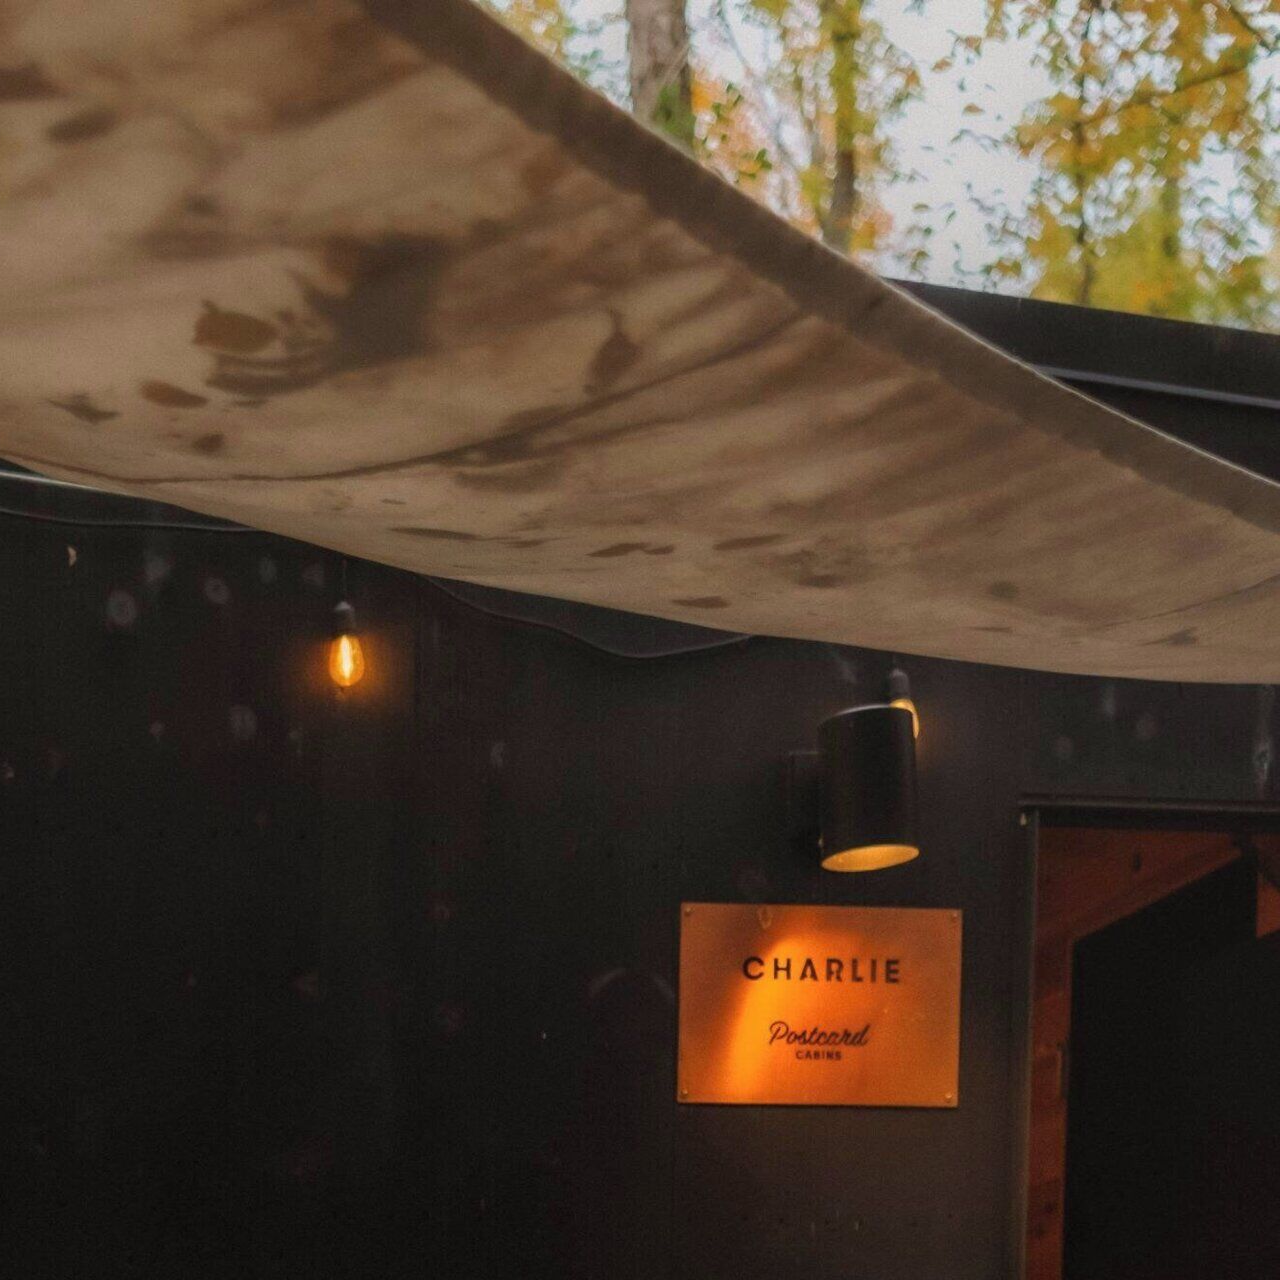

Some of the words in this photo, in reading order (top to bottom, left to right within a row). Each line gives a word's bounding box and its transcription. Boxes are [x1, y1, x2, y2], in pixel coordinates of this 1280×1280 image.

[742, 956, 901, 984] CHARLIE
[769, 1020, 871, 1047] Postcard
[795, 1050, 842, 1060] CABINS
